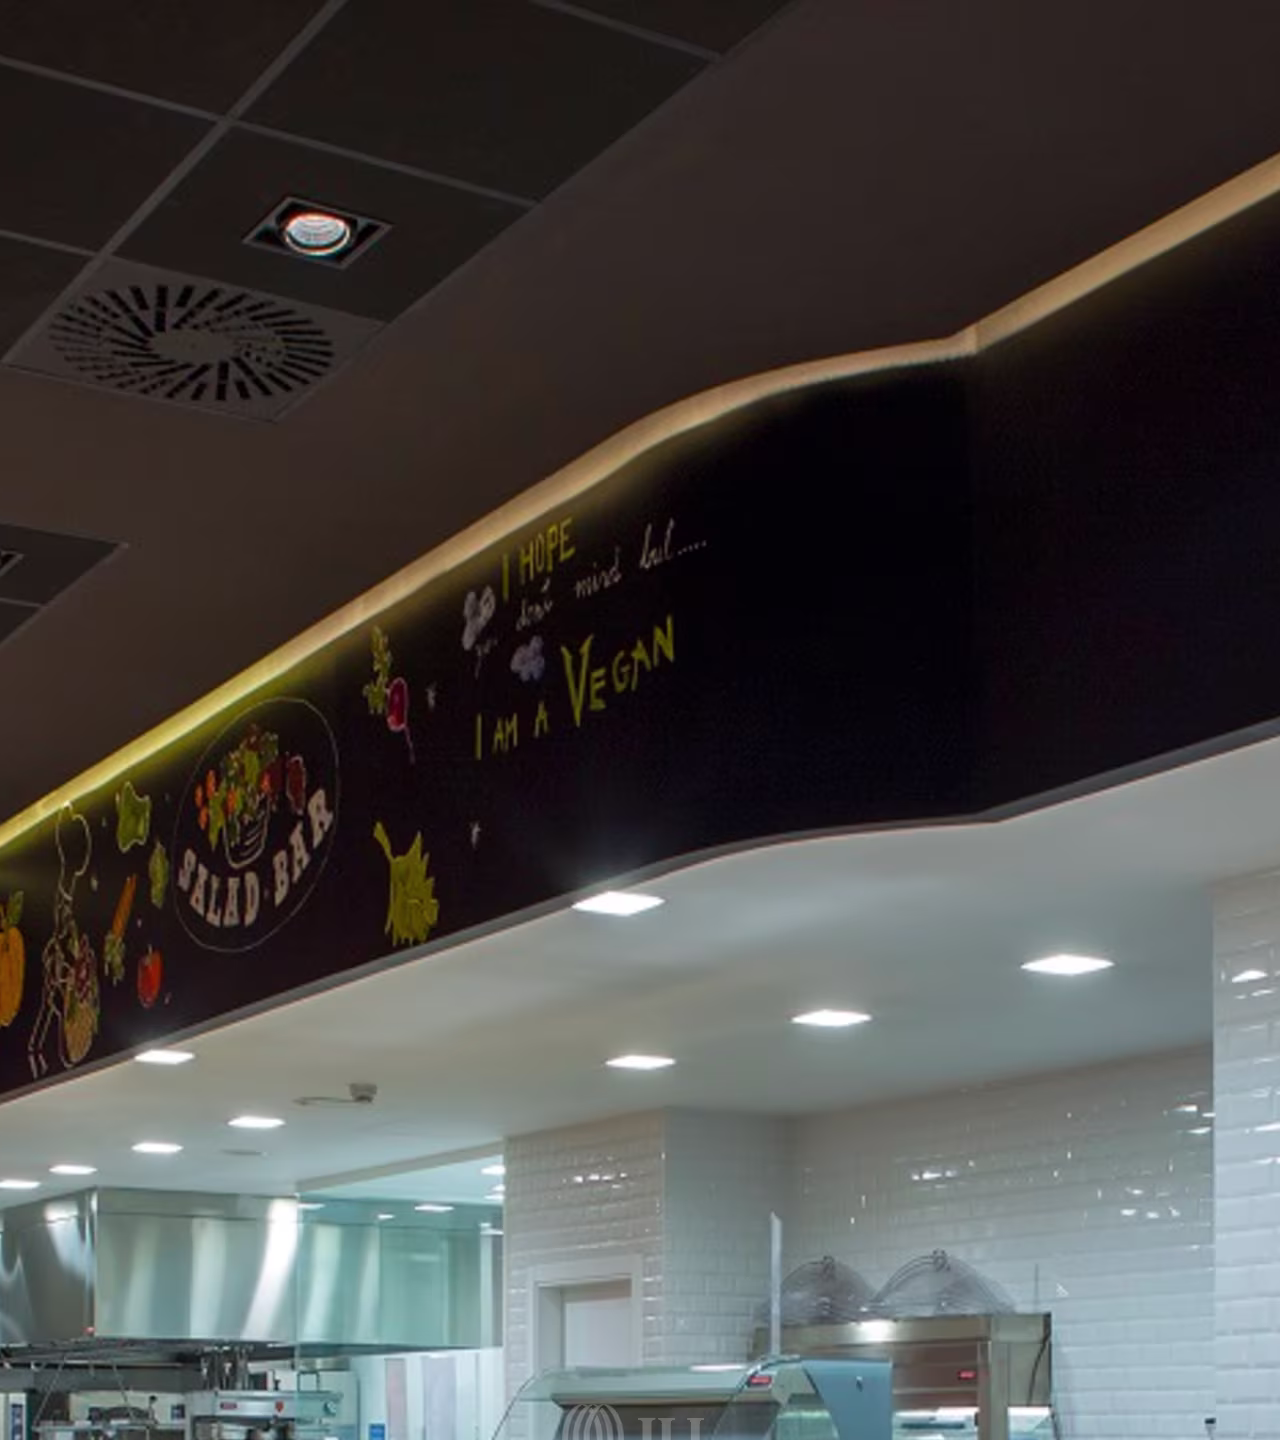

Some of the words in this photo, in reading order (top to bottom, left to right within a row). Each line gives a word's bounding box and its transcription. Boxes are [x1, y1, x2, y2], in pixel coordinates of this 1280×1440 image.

[518, 518, 576, 586] HOPE
[491, 713, 519, 756] AM
[533, 700, 551, 739] A
[560, 612, 676, 728] VEGAN
[176, 847, 261, 928] SALAD
[271, 788, 335, 908] BAR
